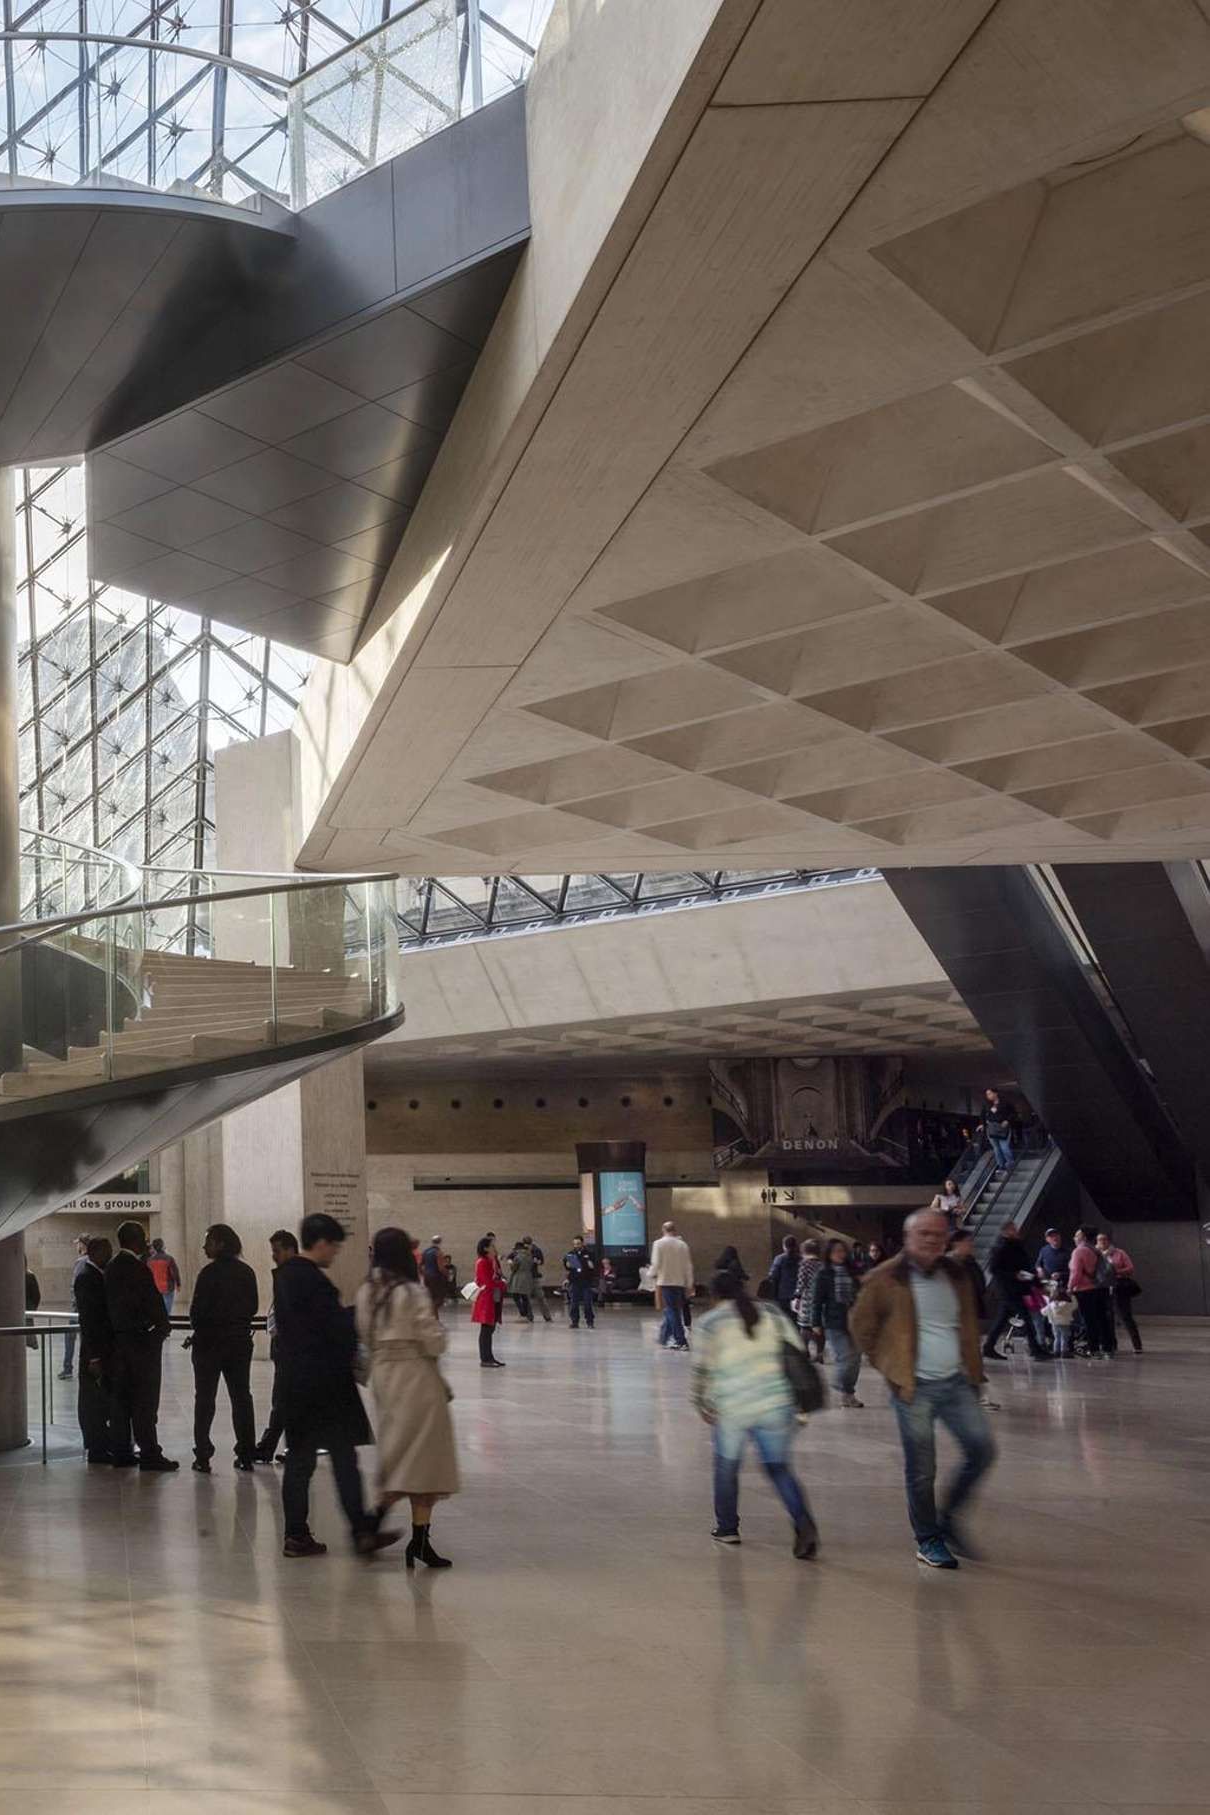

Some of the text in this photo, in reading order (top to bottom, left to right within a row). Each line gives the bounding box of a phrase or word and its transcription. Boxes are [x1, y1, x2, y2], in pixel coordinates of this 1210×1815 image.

[783, 1140, 838, 1150] DENON
[80, 1199, 101, 1209] des
[104, 1200, 152, 1210] groupes
